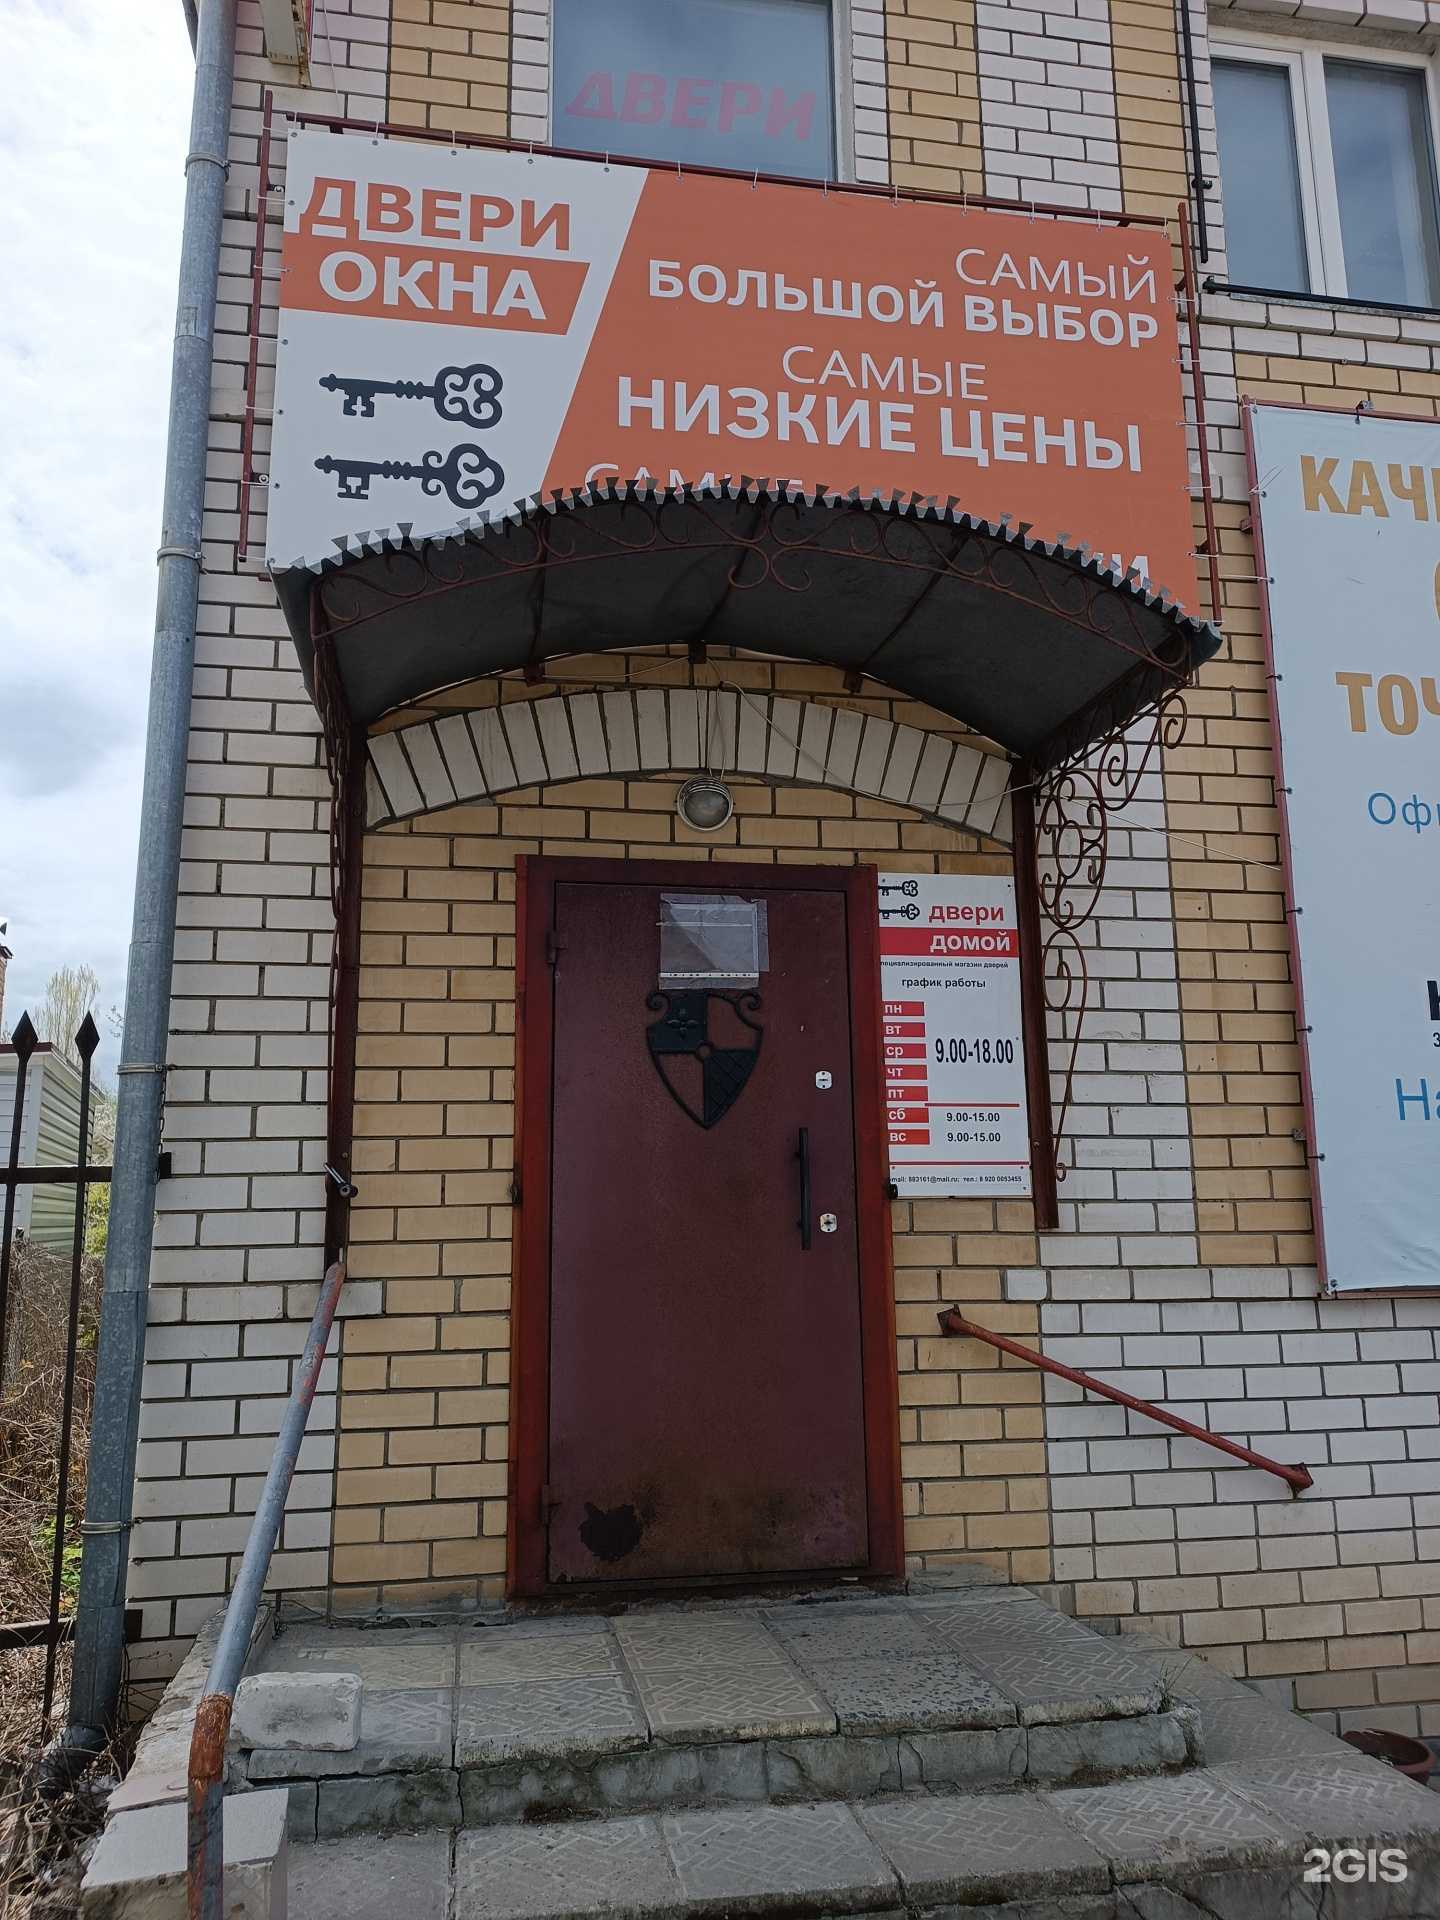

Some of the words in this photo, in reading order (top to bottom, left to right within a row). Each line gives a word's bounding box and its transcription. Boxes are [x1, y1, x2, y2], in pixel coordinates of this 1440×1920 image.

[565, 70, 817, 140] ДВЕРИ
[299, 176, 570, 251] ДВЕРИ
[319, 251, 547, 320] ОКНА
[955, 248, 1157, 304] САМЫЙ
[649, 259, 944, 328] БОЛЬШОЙ
[964, 294, 1159, 348] ВЫБОР
[782, 345, 988, 400] САМЫЕ
[618, 376, 916, 453] НИЗКИЕ
[940, 407, 1142, 472] ЦЕНЫ
[1300, 454, 1440, 522] КАЧ
[1368, 791, 1440, 834] Оф
[928, 905, 1004, 926] двери
[929, 930, 1011, 953] домой
[954, 961, 982, 969] магазин
[901, 977, 942, 989] график
[944, 977, 986, 989] работы
[884, 1004, 902, 1014] пн
[885, 1025, 902, 1035] вт
[886, 1046, 904, 1059] ср
[935, 1038, 1014, 1064] 9.00-18.00
[887, 1067, 904, 1077] чт
[887, 1089, 905, 1099] пт
[888, 1108, 906, 1121] сб
[946, 1112, 1000, 1122] 9.00-15.00
[889, 1132, 907, 1142] вс
[947, 1132, 1001, 1142] 9.00-15.00
